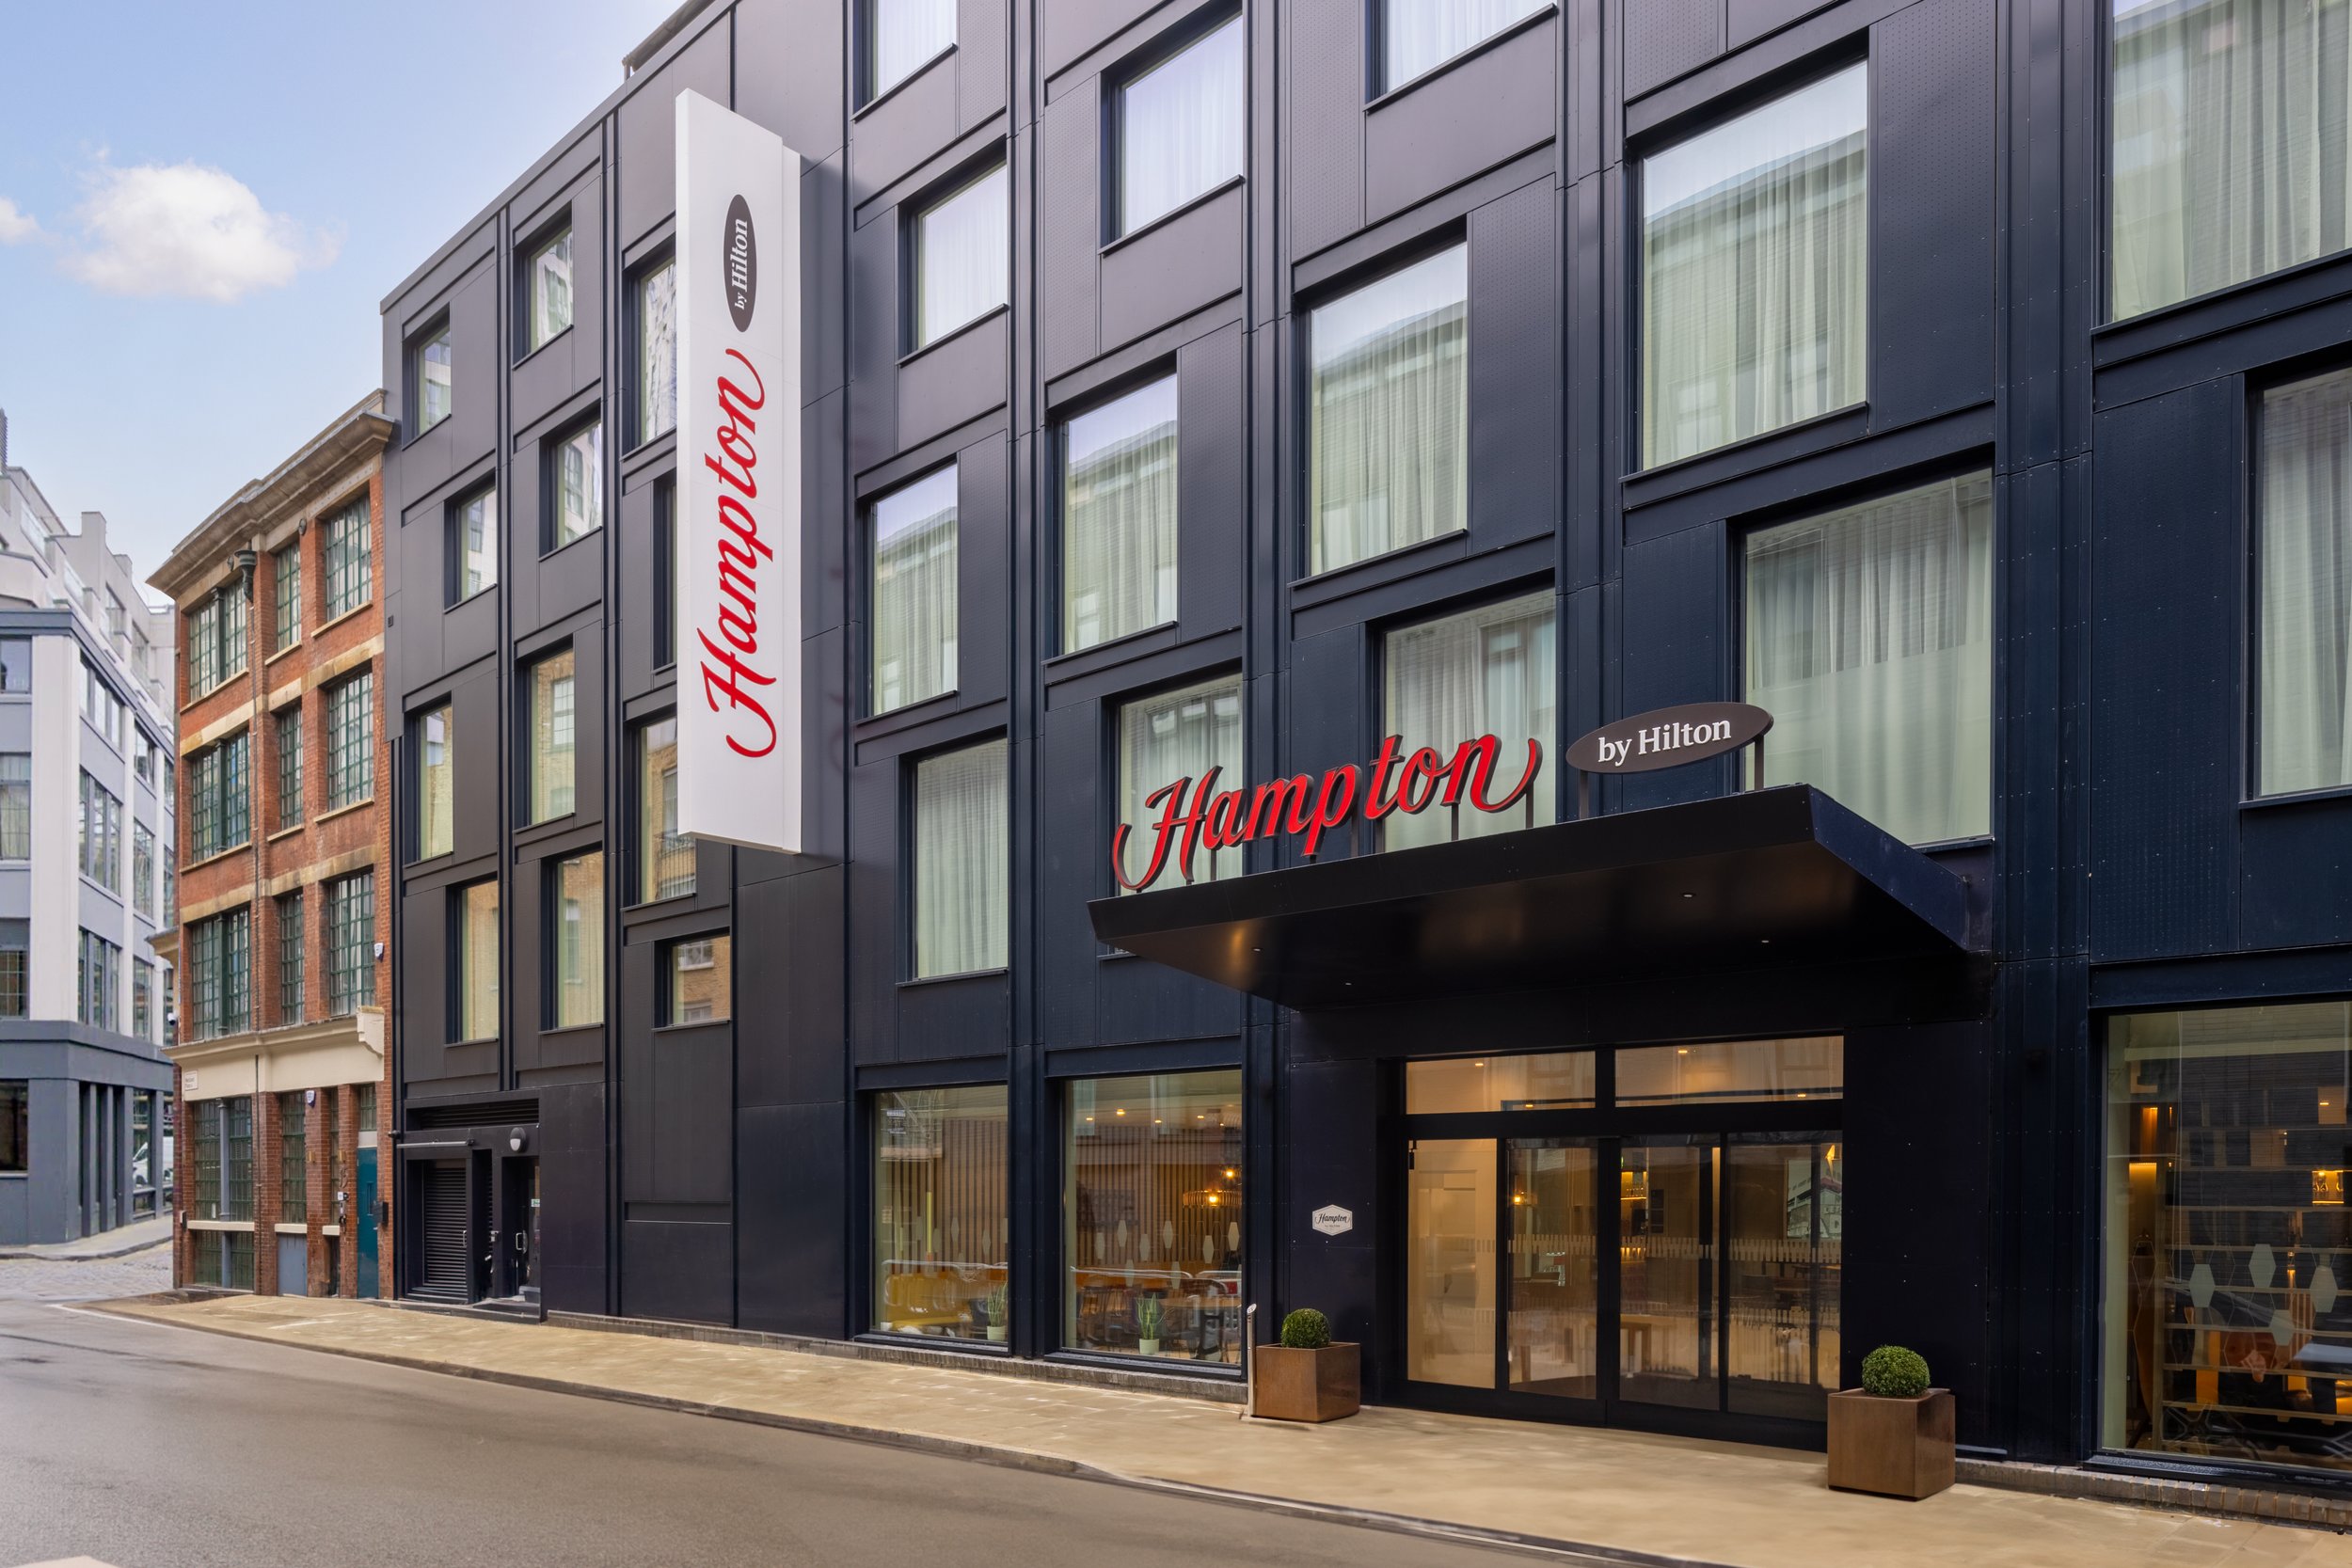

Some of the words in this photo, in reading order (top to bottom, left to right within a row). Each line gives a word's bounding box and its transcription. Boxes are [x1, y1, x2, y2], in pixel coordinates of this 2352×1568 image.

[729, 218, 748, 293] Hilton
[734, 292, 747, 310] by
[696, 348, 776, 758] Hampton
[1597, 736, 1632, 767] by
[1638, 720, 1732, 755] Hilton
[1111, 734, 1543, 891] Hampton
[1315, 1212, 1351, 1225] Hampton
